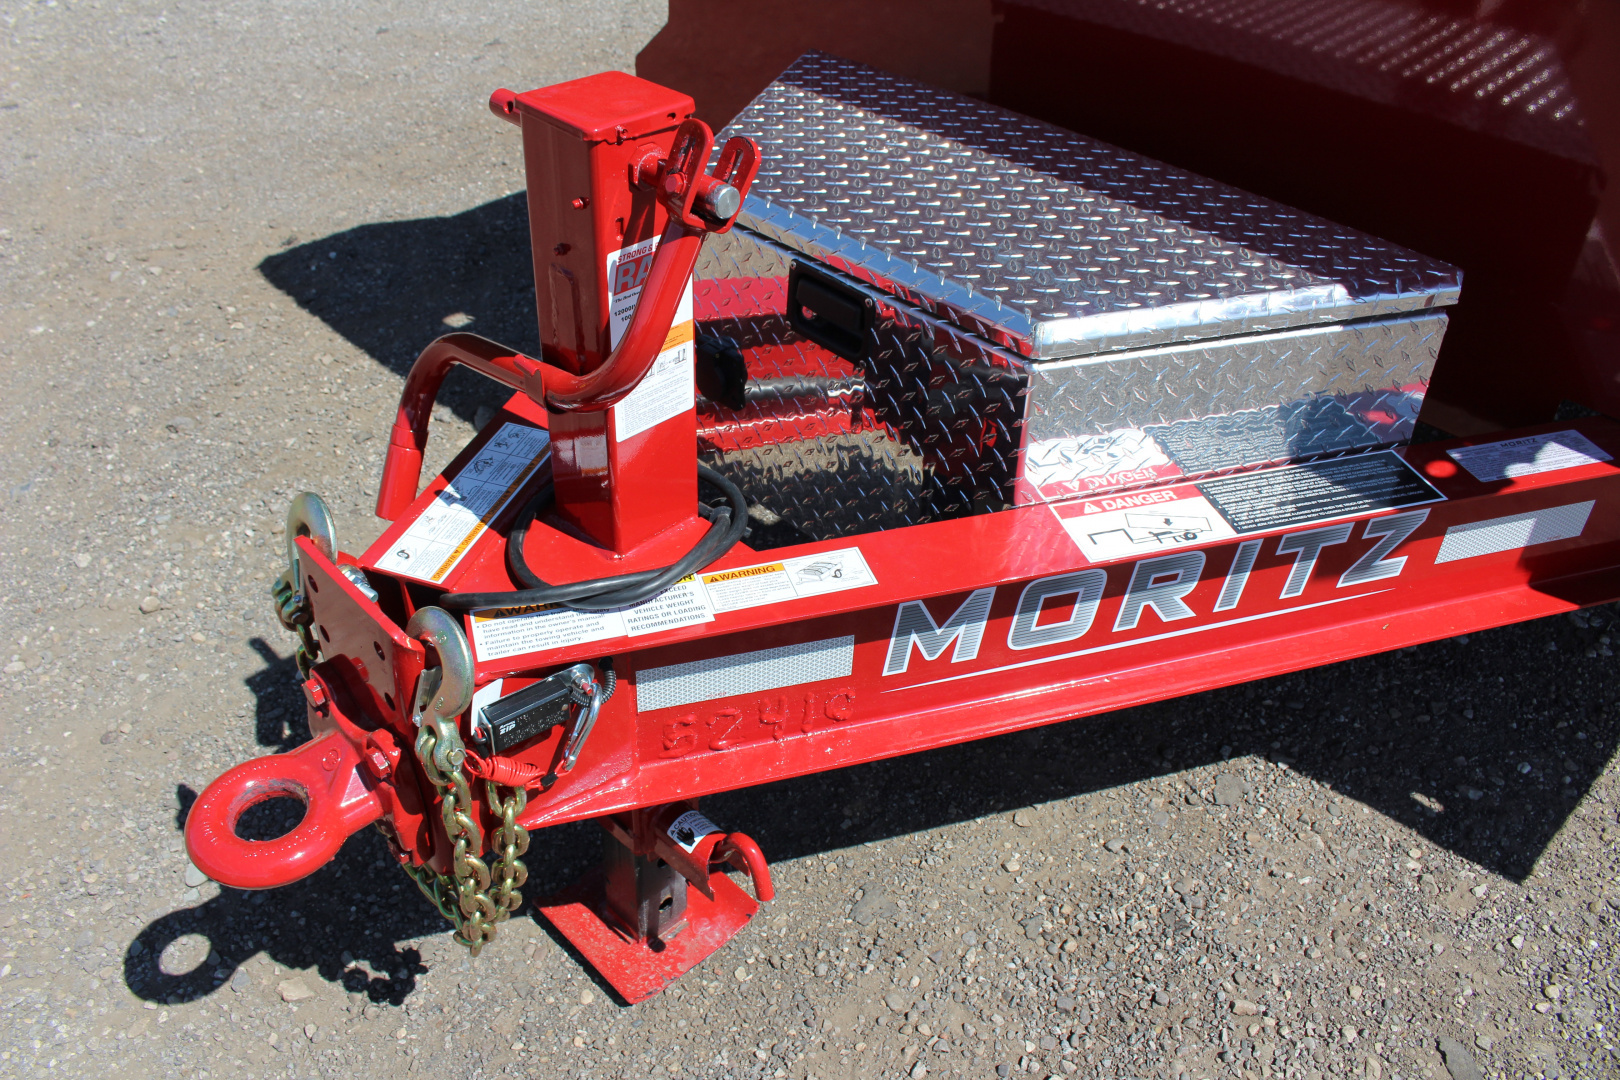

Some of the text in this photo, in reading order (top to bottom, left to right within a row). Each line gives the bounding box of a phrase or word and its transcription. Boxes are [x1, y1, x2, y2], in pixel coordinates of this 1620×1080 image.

[617, 247, 647, 264] STRONG
[615, 254, 653, 294] RA
[1500, 437, 1538, 449] MORITZ
[1101, 490, 1178, 511] DANGER
[433, 554, 456, 580] WARNING
[718, 565, 776, 581] WARNING
[628, 591, 695, 608] MANUFACTURER'S
[881, 508, 1432, 677] MORITZ
[627, 613, 660, 624] RATINGS
[674, 604, 706, 616] LOADING
[634, 598, 694, 615] VEHICLE WEIGHT
[483, 627, 525, 639] information
[547, 618, 576, 627] owner's
[507, 615, 533, 624] operate
[534, 613, 574, 624] understand
[485, 637, 510, 645] Failure
[521, 629, 553, 640] properly
[555, 624, 584, 633] operate
[486, 641, 519, 650] maintain
[535, 633, 560, 643] towing
[562, 628, 588, 637] vehicle
[487, 648, 510, 656] trailer
[528, 641, 549, 649] result
[560, 635, 584, 644] injury.
[673, 811, 698, 830] CAUTIO
